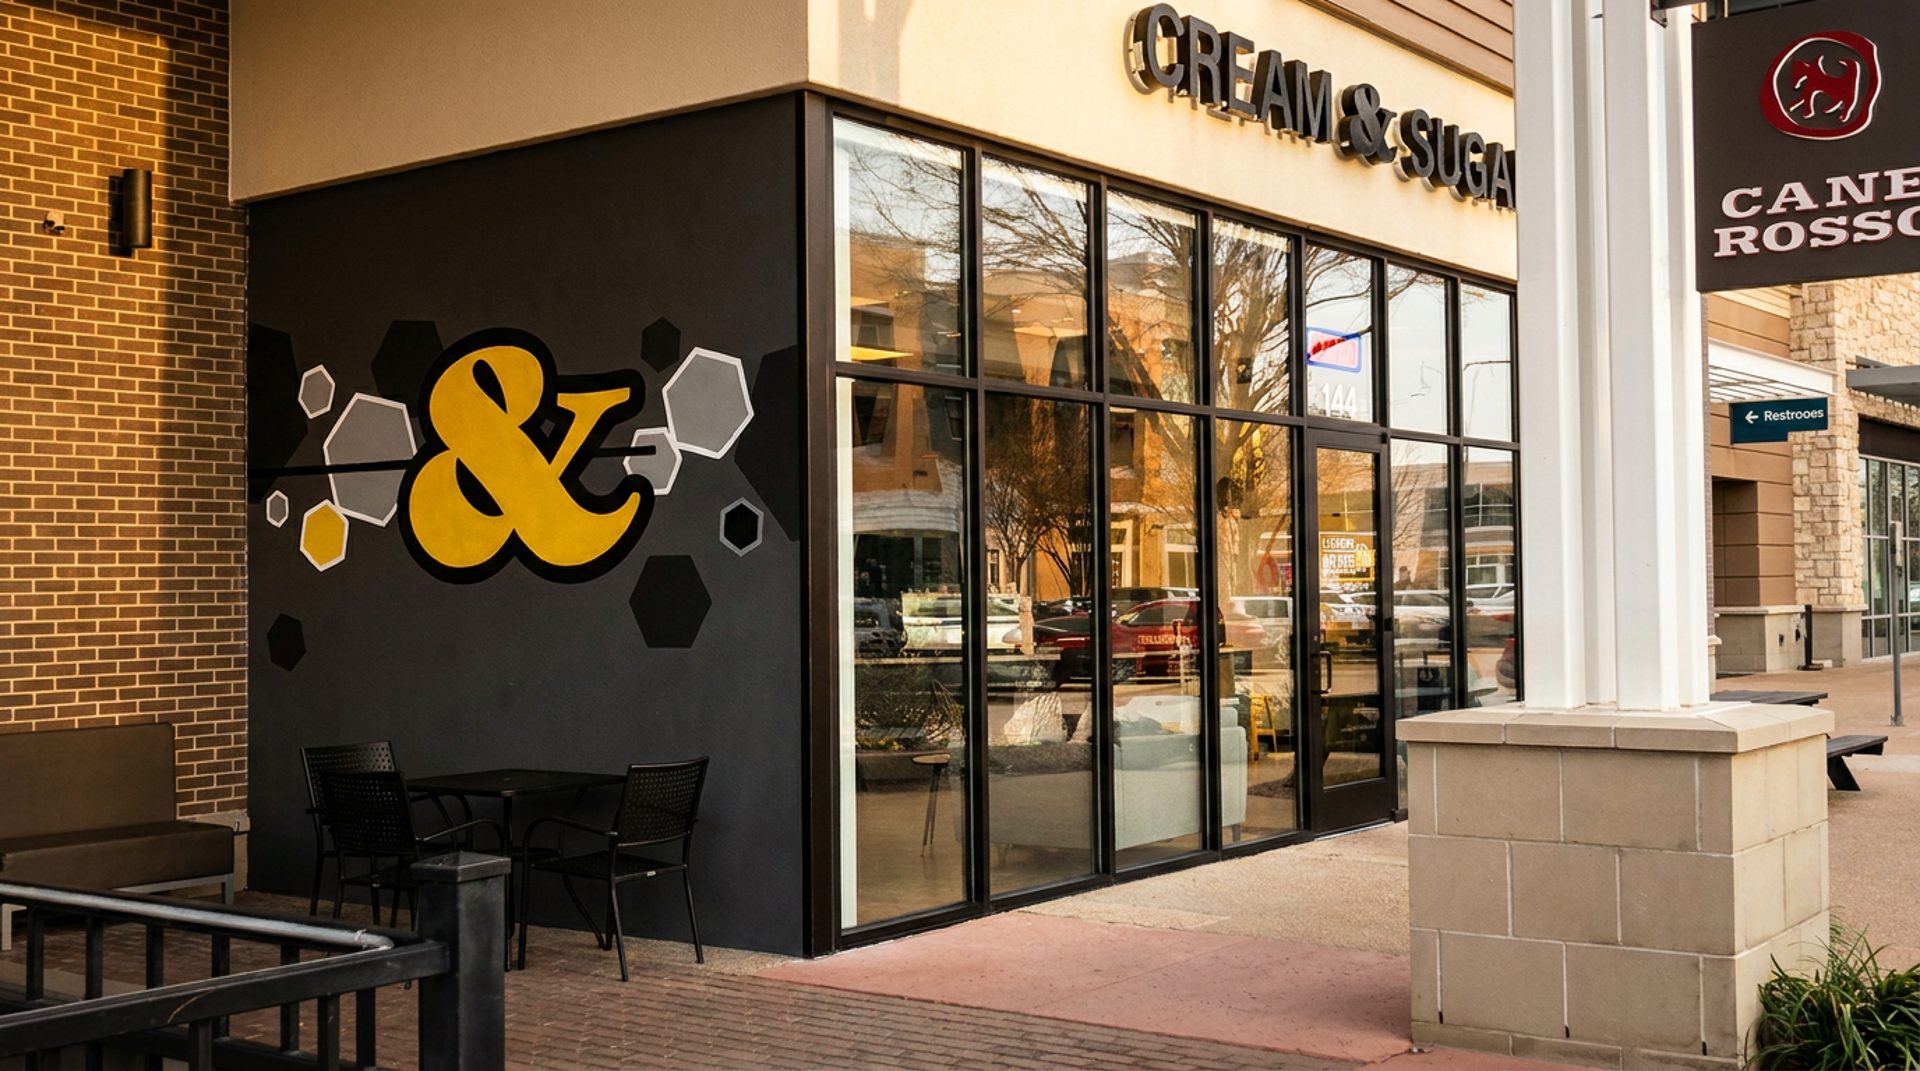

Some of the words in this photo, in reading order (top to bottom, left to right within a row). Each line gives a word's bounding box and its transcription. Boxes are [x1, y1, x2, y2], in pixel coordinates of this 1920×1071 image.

[1132, 3, 1332, 144] CREAM
[1338, 83, 1397, 164] &
[1399, 109, 1516, 208] SUGA
[1721, 167, 1920, 219] CANE
[407, 343, 643, 570] &
[1321, 383, 1357, 417] 144
